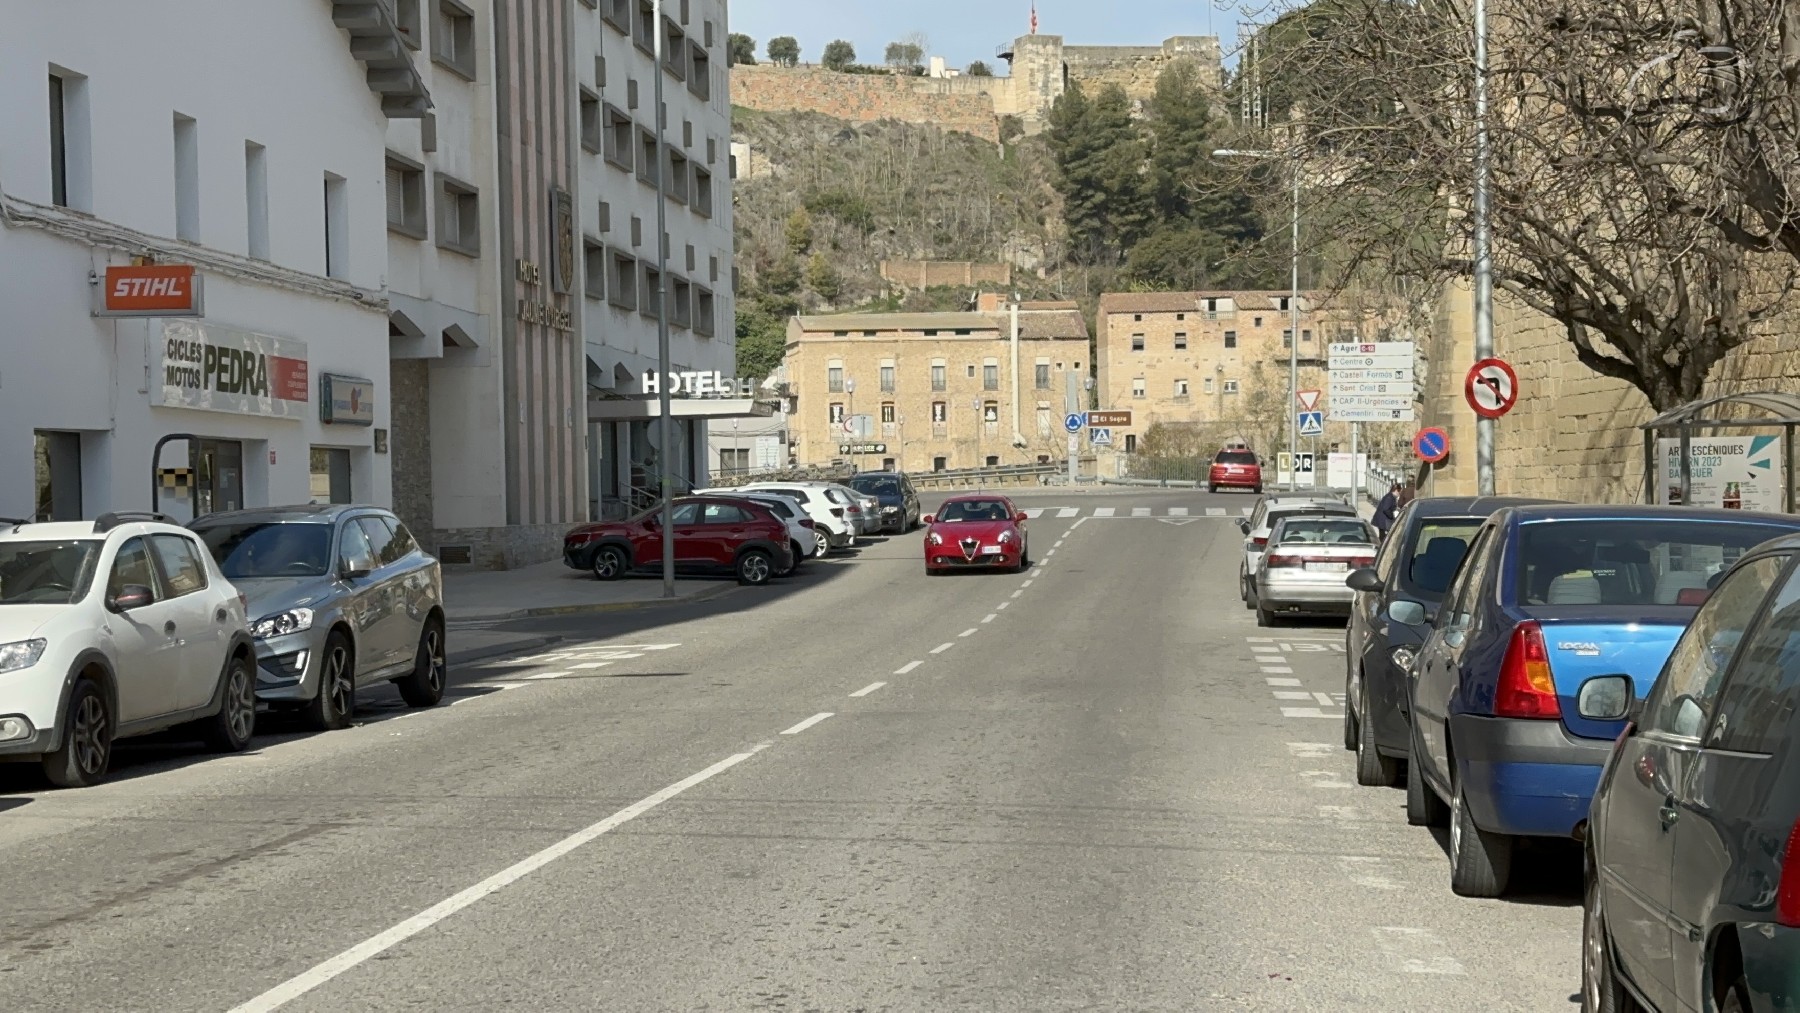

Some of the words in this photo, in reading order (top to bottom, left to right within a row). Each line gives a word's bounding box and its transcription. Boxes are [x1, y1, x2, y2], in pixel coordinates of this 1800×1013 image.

[114, 277, 183, 297] STIHL
[167, 338, 202, 363] CICLES
[1340, 358, 1363, 366] Centre
[204, 343, 269, 398] PEDRA
[1340, 370, 1363, 379] Castell
[166, 365, 200, 389] MOTOS
[642, 370, 730, 394] HOTEL
[1339, 397, 1355, 405] CAP
[1340, 409, 1374, 417] Cementiri
[1692, 443, 1744, 456] ESCÈNIQUES
[1668, 457, 1699, 467] HIVRN
[1701, 456, 1722, 467] 2023
[1668, 467, 1713, 479] BAGUER
